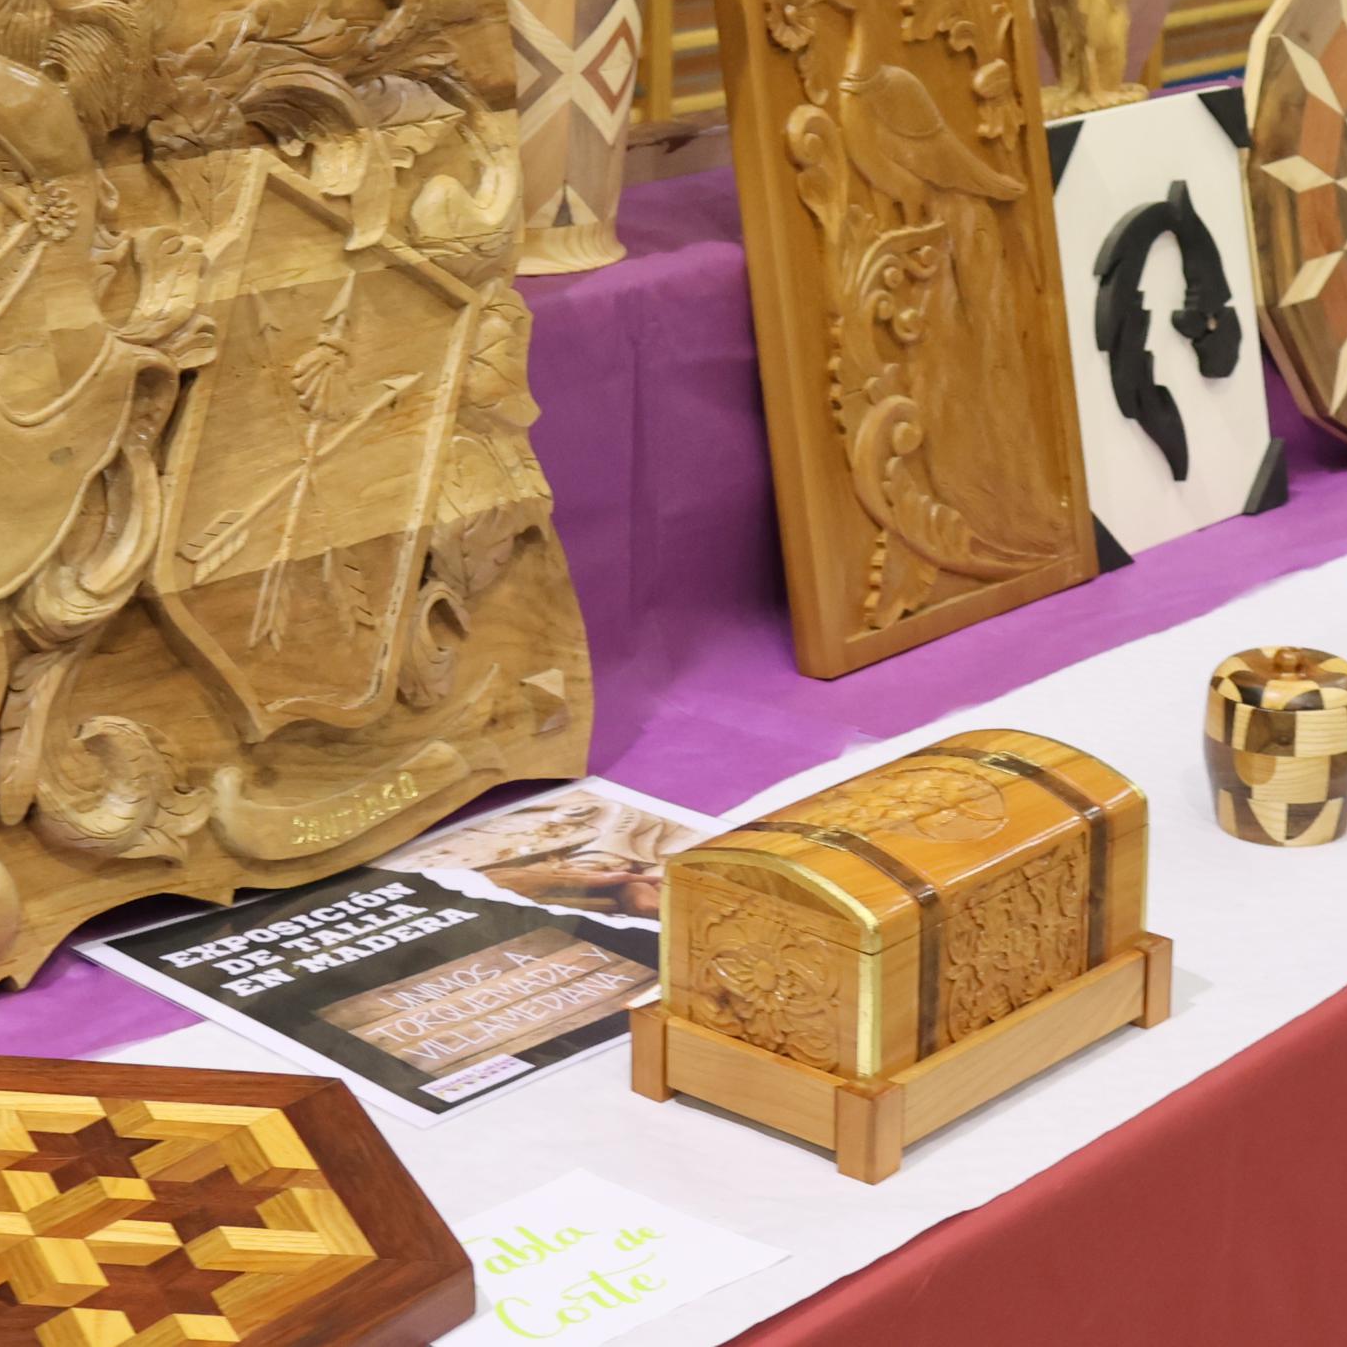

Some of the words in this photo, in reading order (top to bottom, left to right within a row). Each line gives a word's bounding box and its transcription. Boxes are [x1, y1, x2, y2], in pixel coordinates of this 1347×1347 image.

[159, 881, 417, 968] EXPOSICIÓN
[212, 949, 285, 976] DE
[280, 903, 428, 953] TALLA
[220, 968, 296, 997] EN
[291, 907, 479, 974] MADERA
[365, 961, 587, 1043] TORQUEMADA
[579, 947, 612, 963] Y
[379, 962, 502, 1013] UNIMOS
[503, 951, 542, 968] A
[402, 970, 636, 1060] VILLAMEDIANA
[460, 1225, 599, 1275] abla
[494, 1252, 667, 1340] Corte
